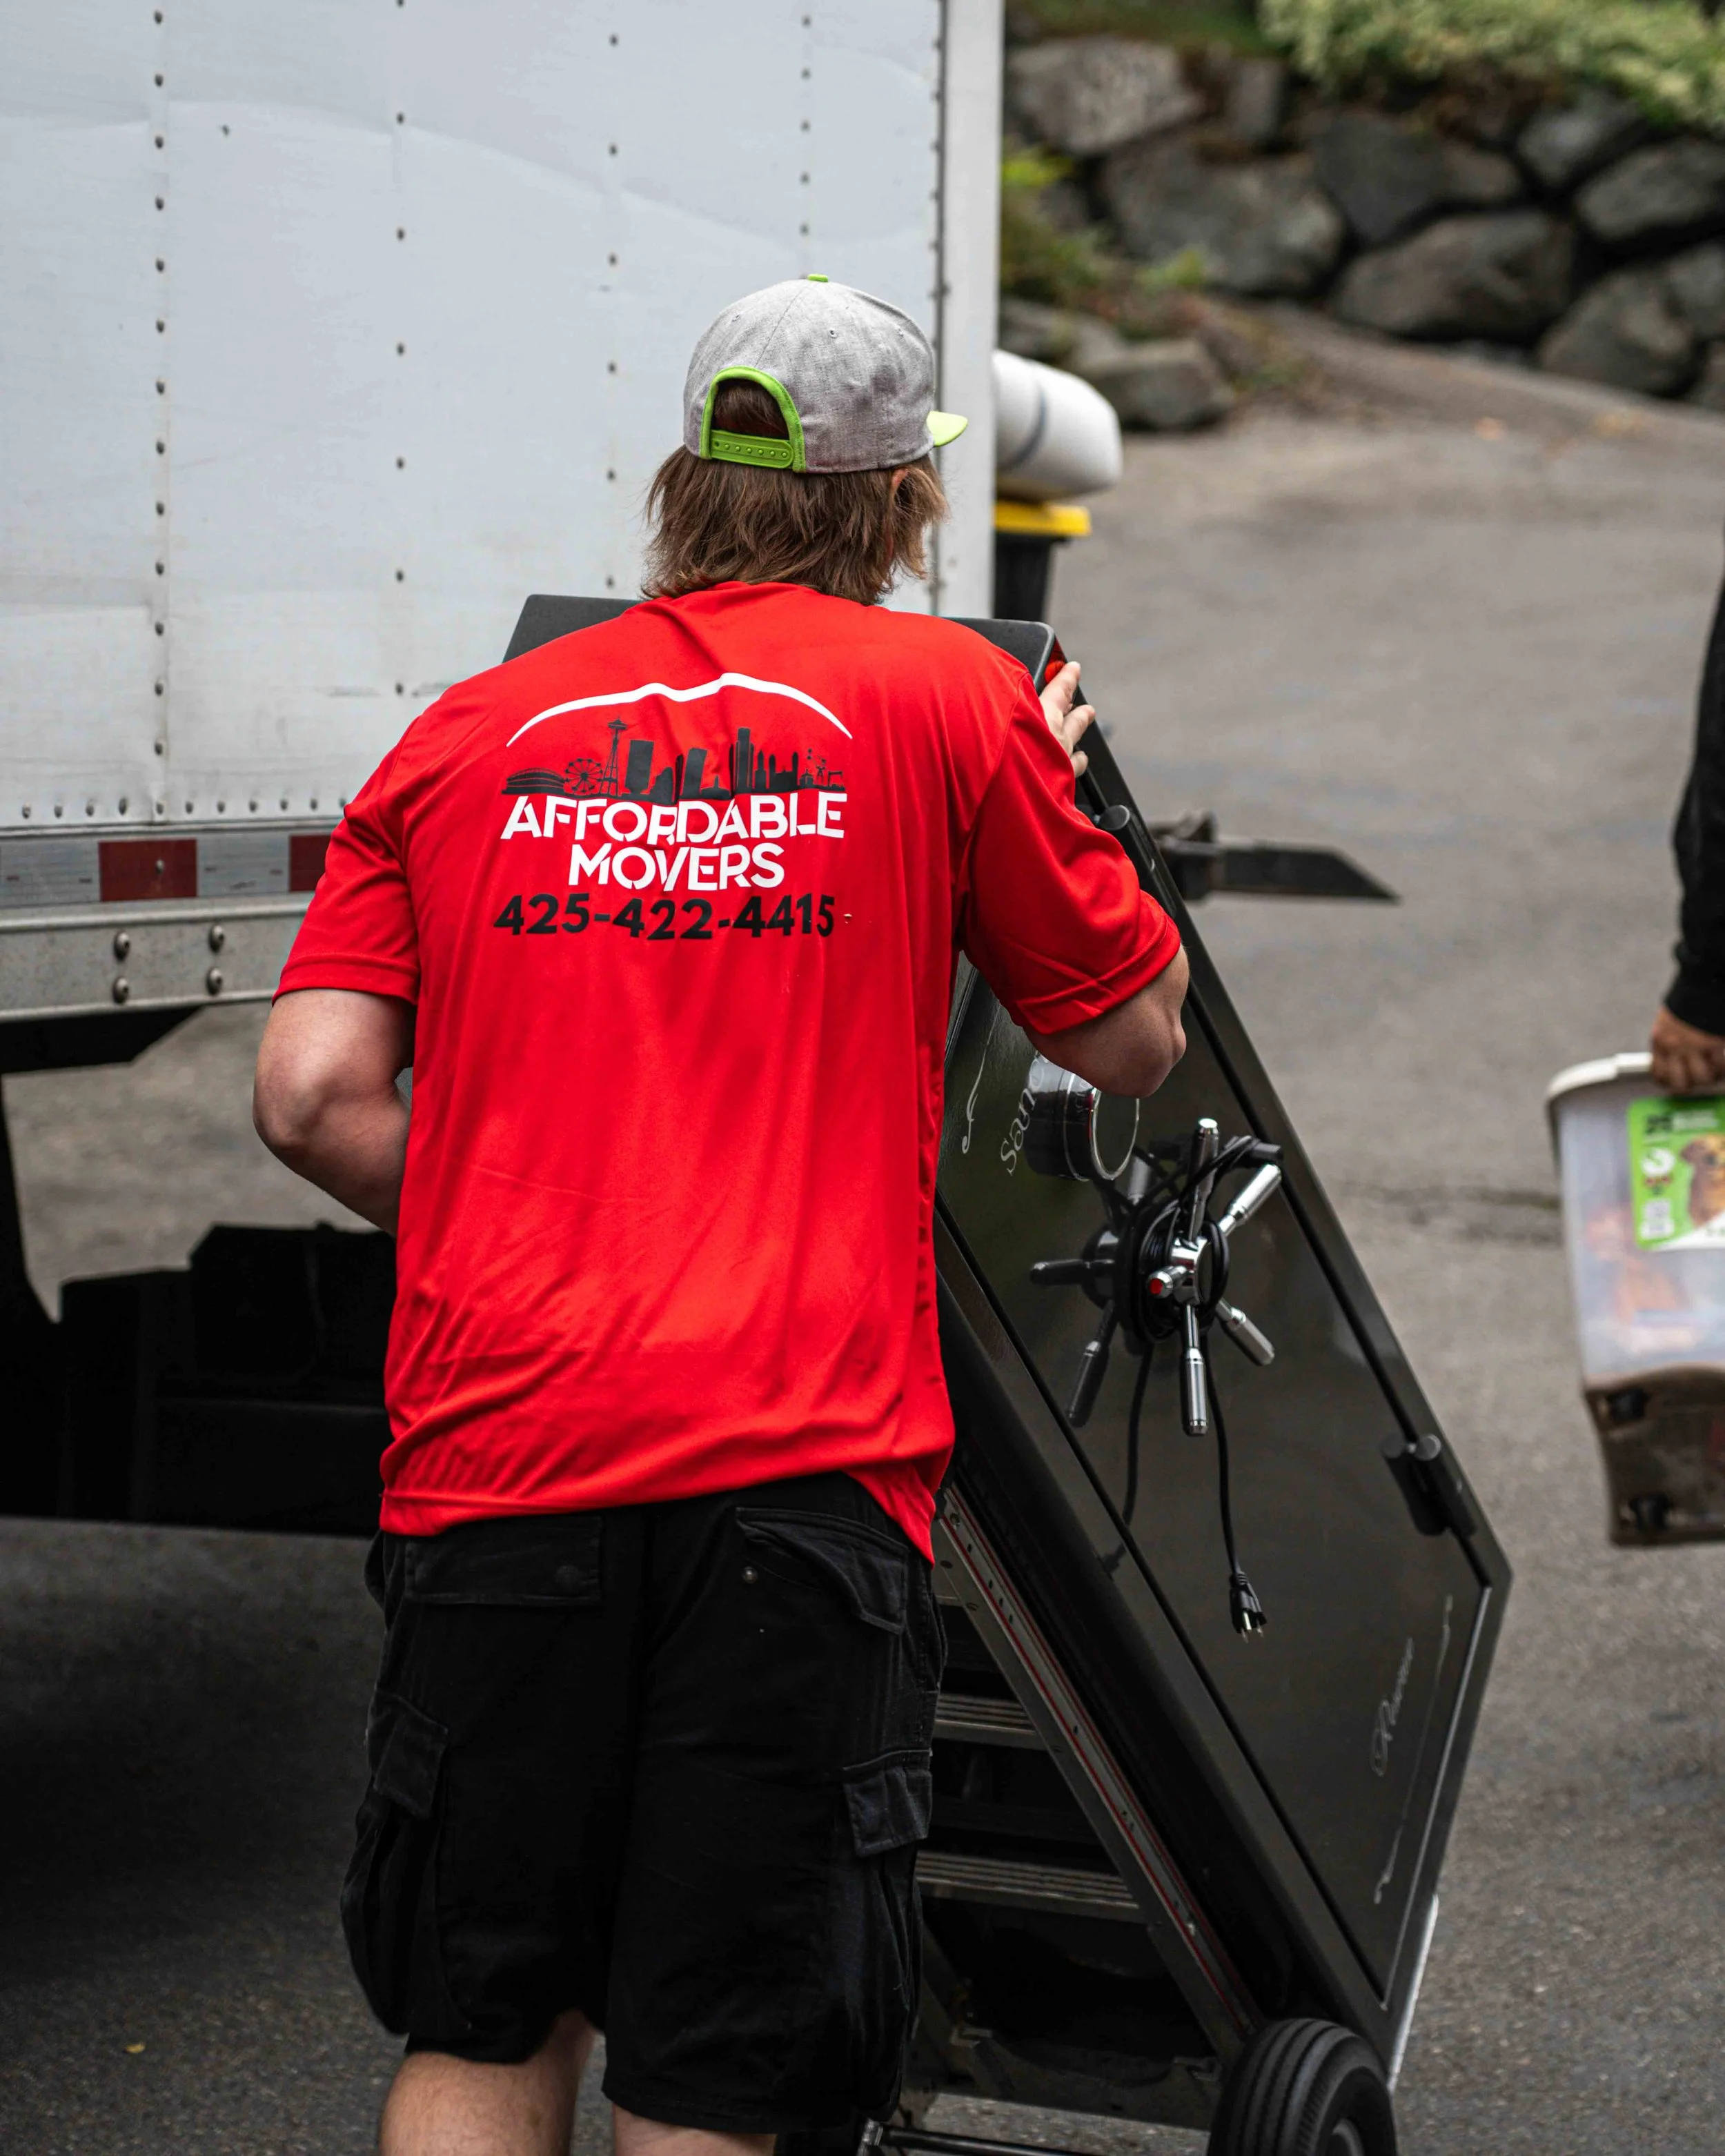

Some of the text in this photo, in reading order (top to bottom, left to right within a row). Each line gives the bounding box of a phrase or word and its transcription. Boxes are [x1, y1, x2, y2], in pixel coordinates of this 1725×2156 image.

[500, 791, 847, 846] AFFORDABLE
[568, 842, 785, 891] MOVERS
[493, 892, 835, 940] 425-422-4415
